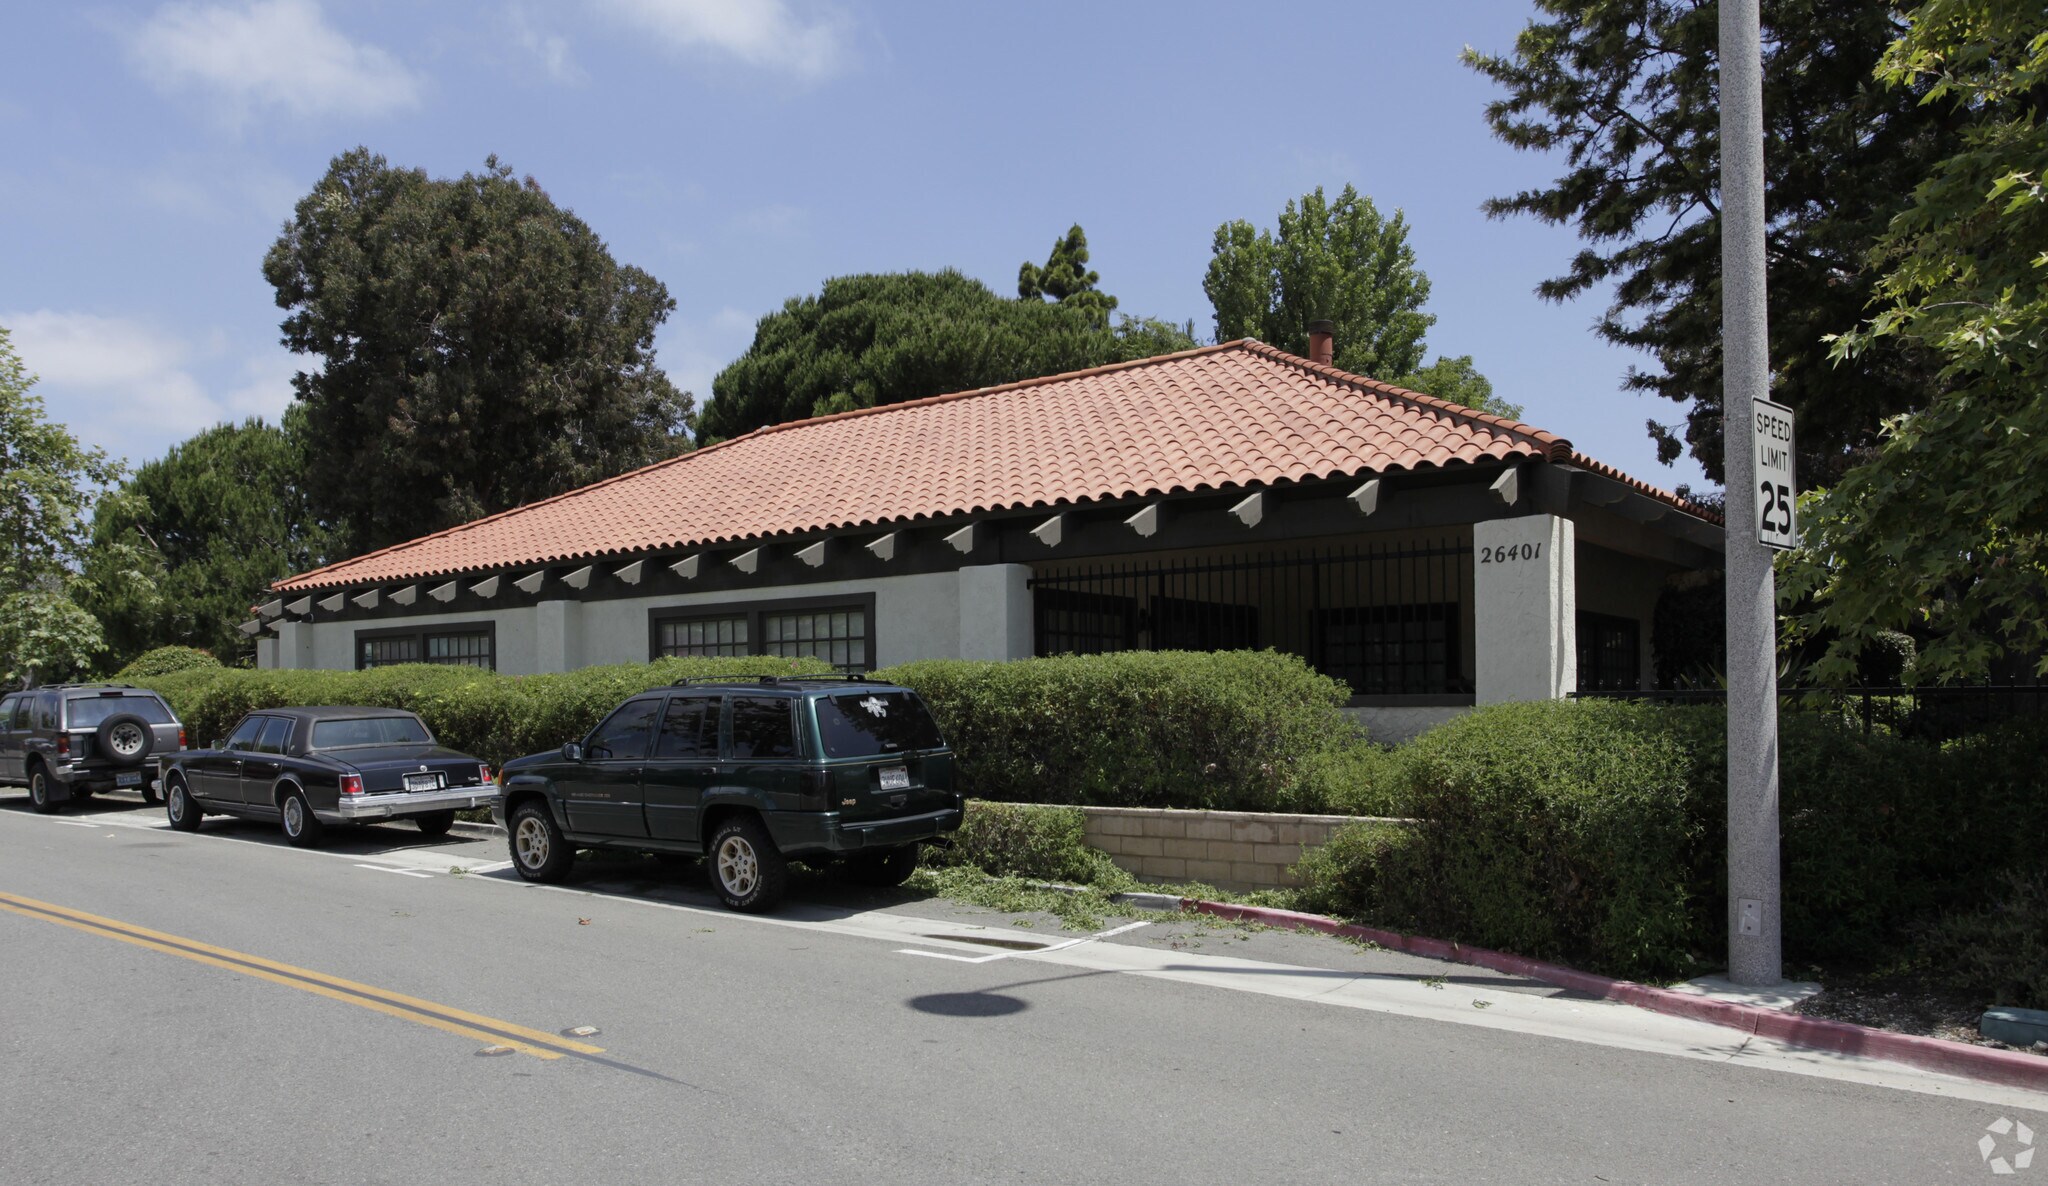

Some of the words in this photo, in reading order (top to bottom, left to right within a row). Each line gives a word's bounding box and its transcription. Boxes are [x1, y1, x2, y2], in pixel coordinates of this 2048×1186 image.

[1756, 412, 1791, 442] SPEED
[1760, 445, 1787, 472] LIMIT
[1760, 480, 1791, 535] 25
[1481, 542, 1541, 564] 26401
